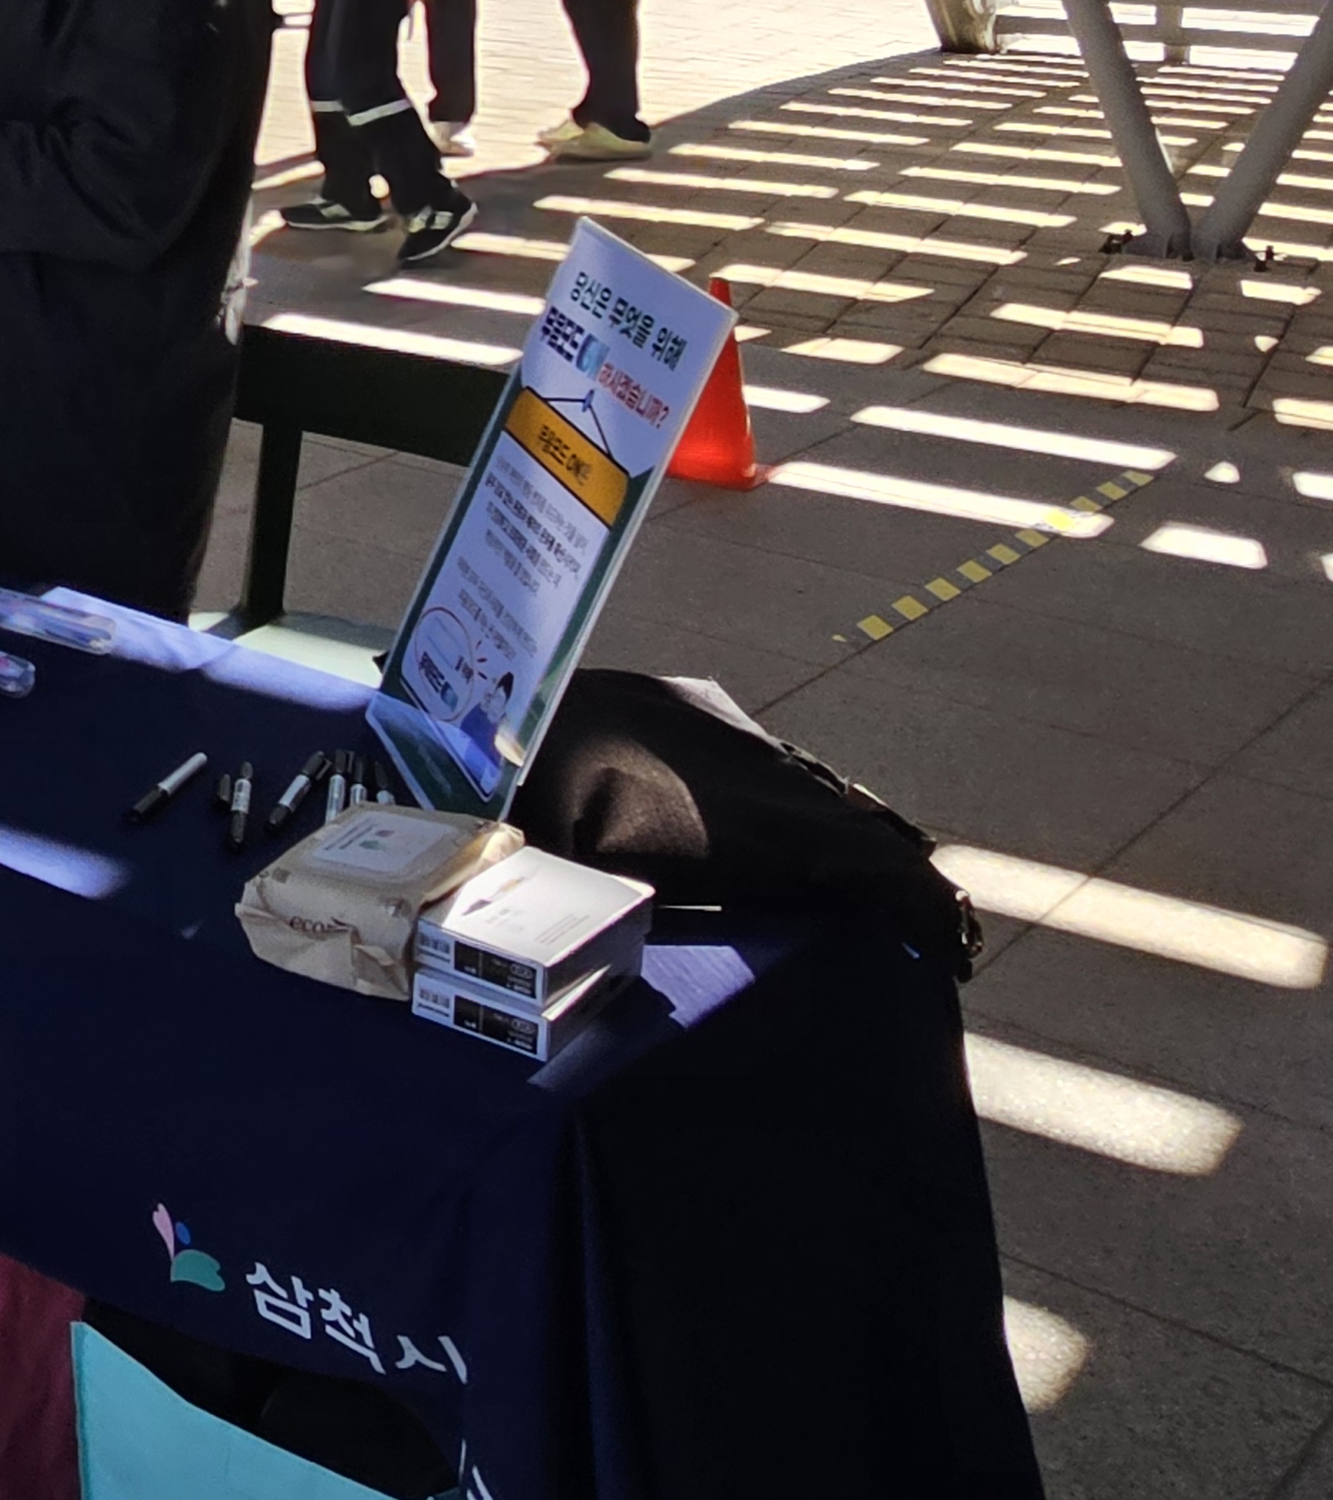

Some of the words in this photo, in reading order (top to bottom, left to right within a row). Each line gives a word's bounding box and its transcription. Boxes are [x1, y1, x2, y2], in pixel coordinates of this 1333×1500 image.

[568, 270, 613, 320] 당신은
[610, 295, 655, 351] 무엇을
[654, 325, 687, 372] 위해
[597, 360, 671, 430] 하시겠습니까?
[245, 1261, 469, 1384] 삼척시
